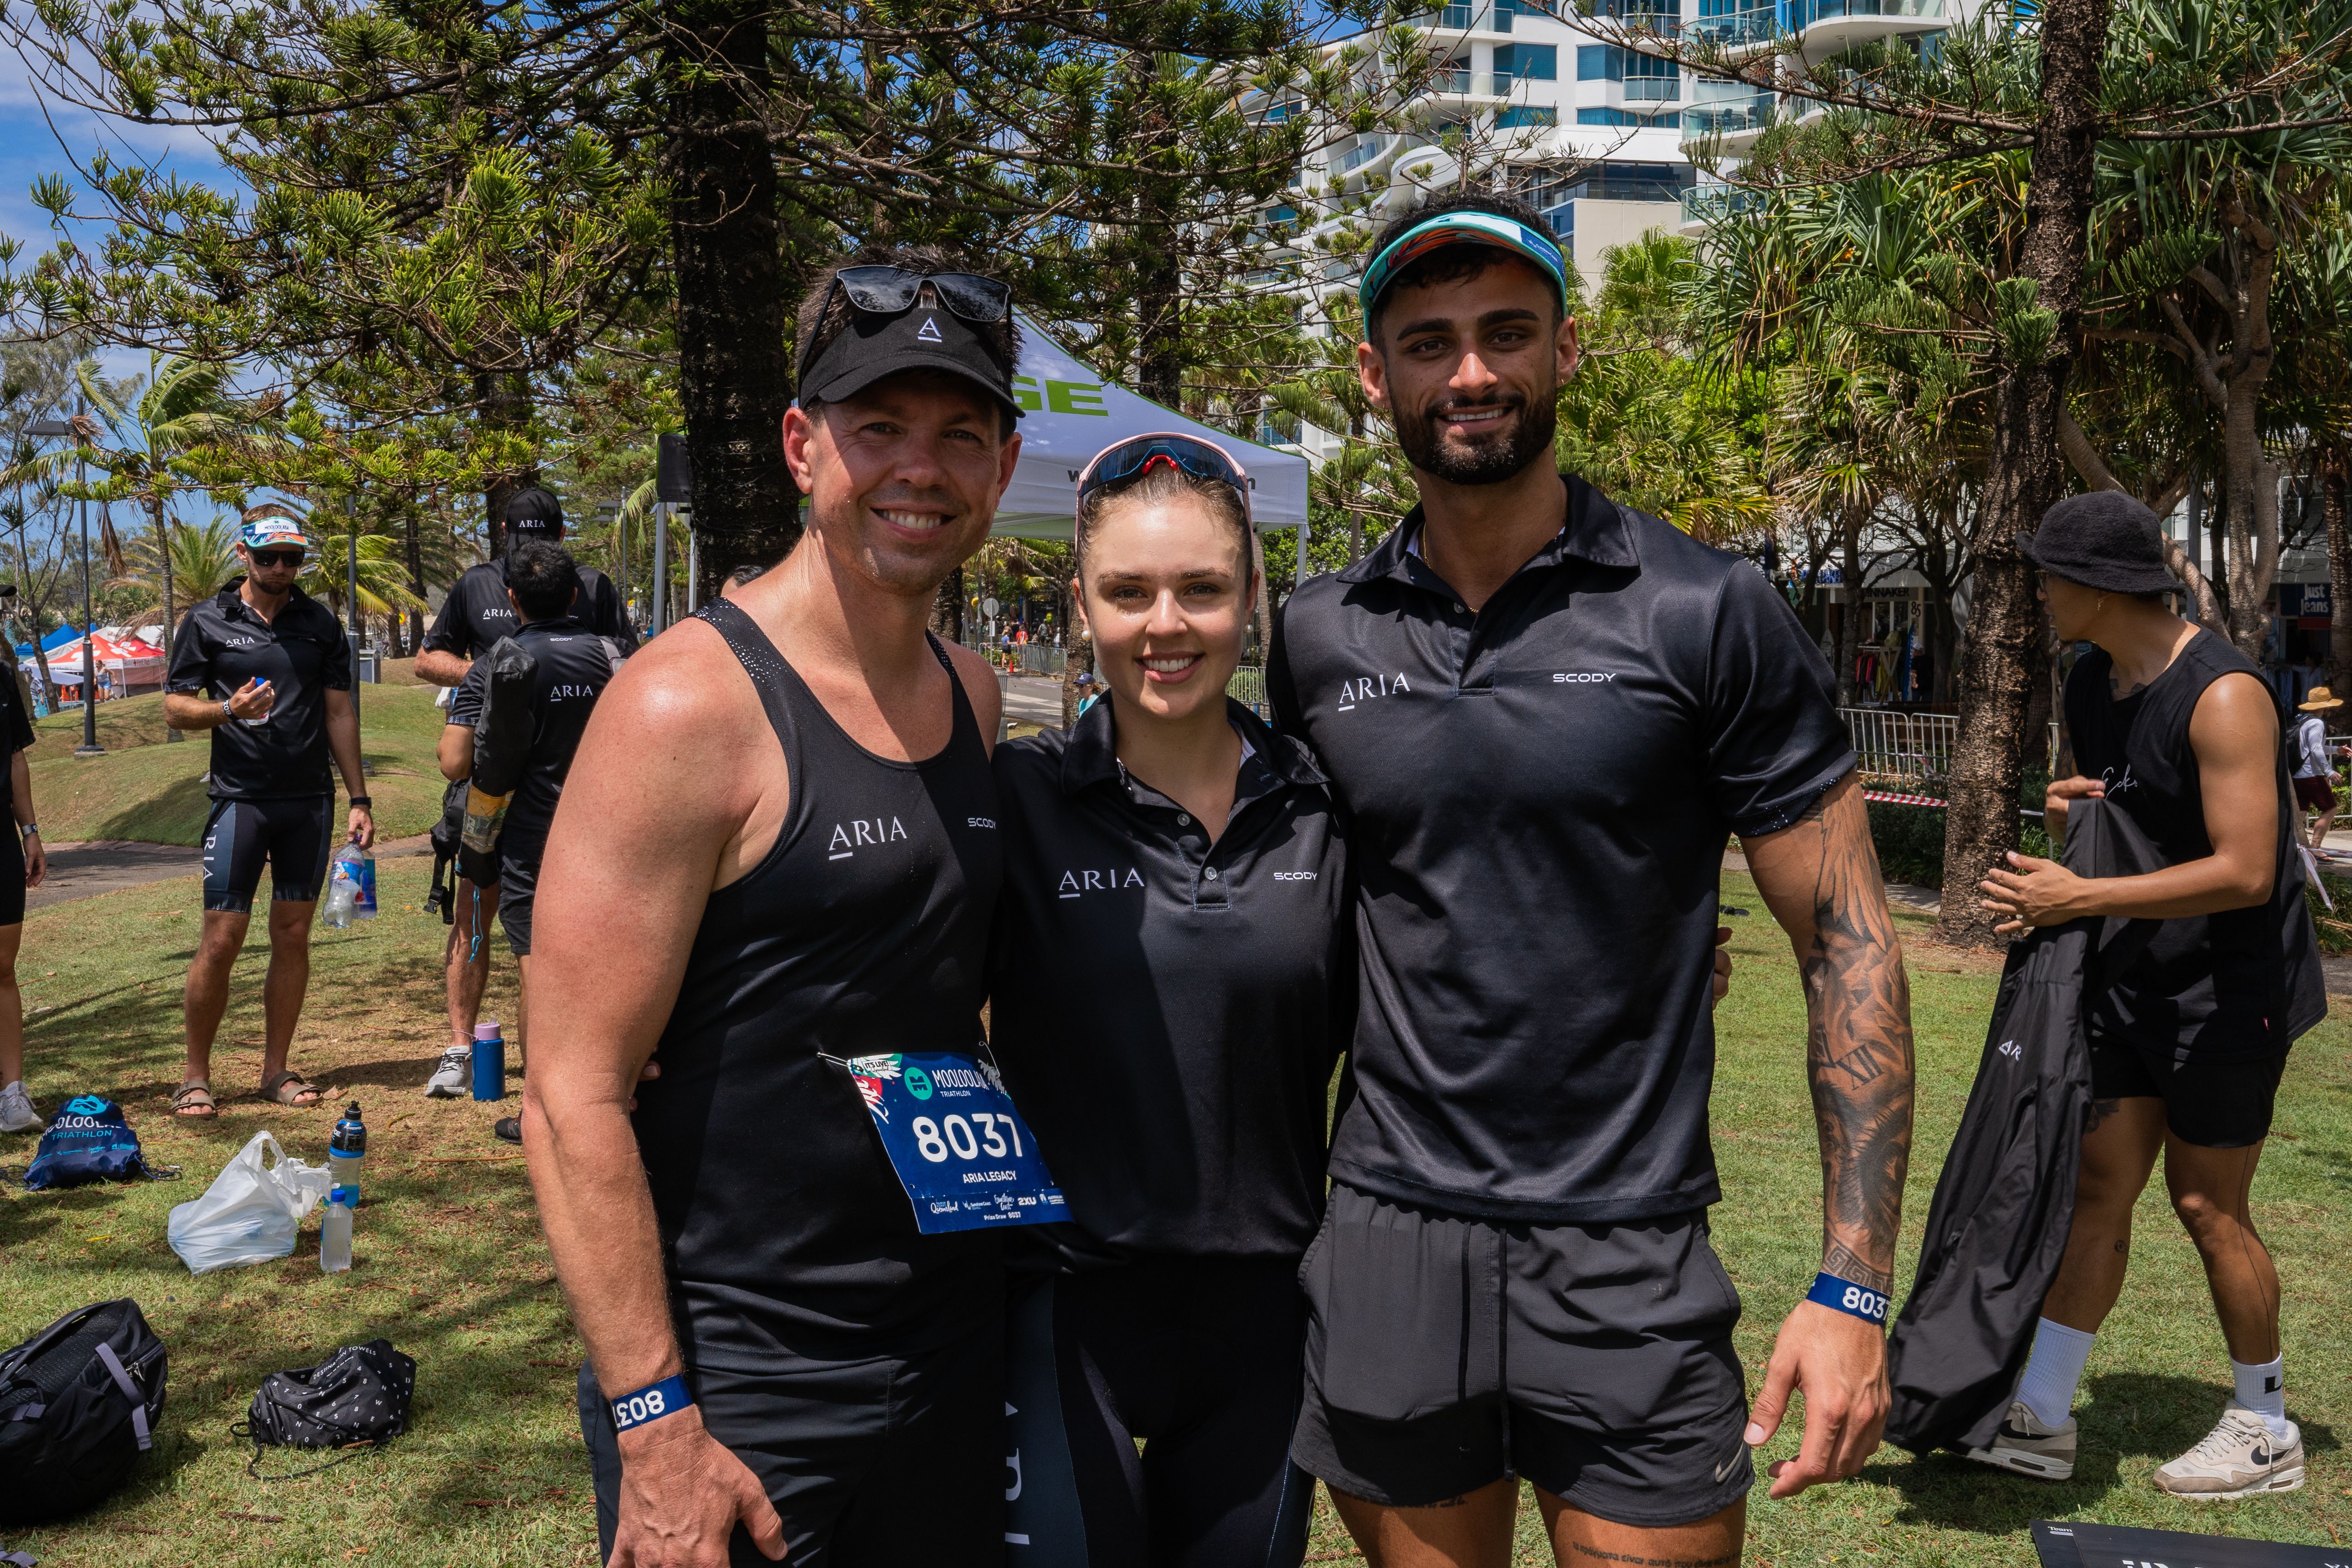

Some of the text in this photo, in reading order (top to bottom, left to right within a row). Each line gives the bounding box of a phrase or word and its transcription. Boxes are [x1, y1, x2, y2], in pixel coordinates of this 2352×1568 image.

[2304, 583, 2325, 601] Just
[483, 609, 513, 620] ARIA
[1911, 601, 1921, 617] 85
[2301, 599, 2329, 616] Jeans
[226, 636, 255, 647] ARIA
[1553, 673, 1616, 683] SCODY
[551, 685, 593, 701] ARIA
[1338, 672, 1410, 712] ARIA
[968, 817, 996, 830] SCODY
[828, 816, 907, 860] ARIA
[203, 824, 218, 881] RIA
[1059, 867, 1145, 898] ARIA
[1273, 871, 1318, 881] SCODY
[51, 1130, 112, 1141] TRIATHLON
[912, 1113, 1023, 1162] 8037
[962, 1170, 1017, 1183] ARIA LEGACY
[1017, 1197, 1037, 1206] 2XU
[348, 1346, 376, 1356] TOWELS
